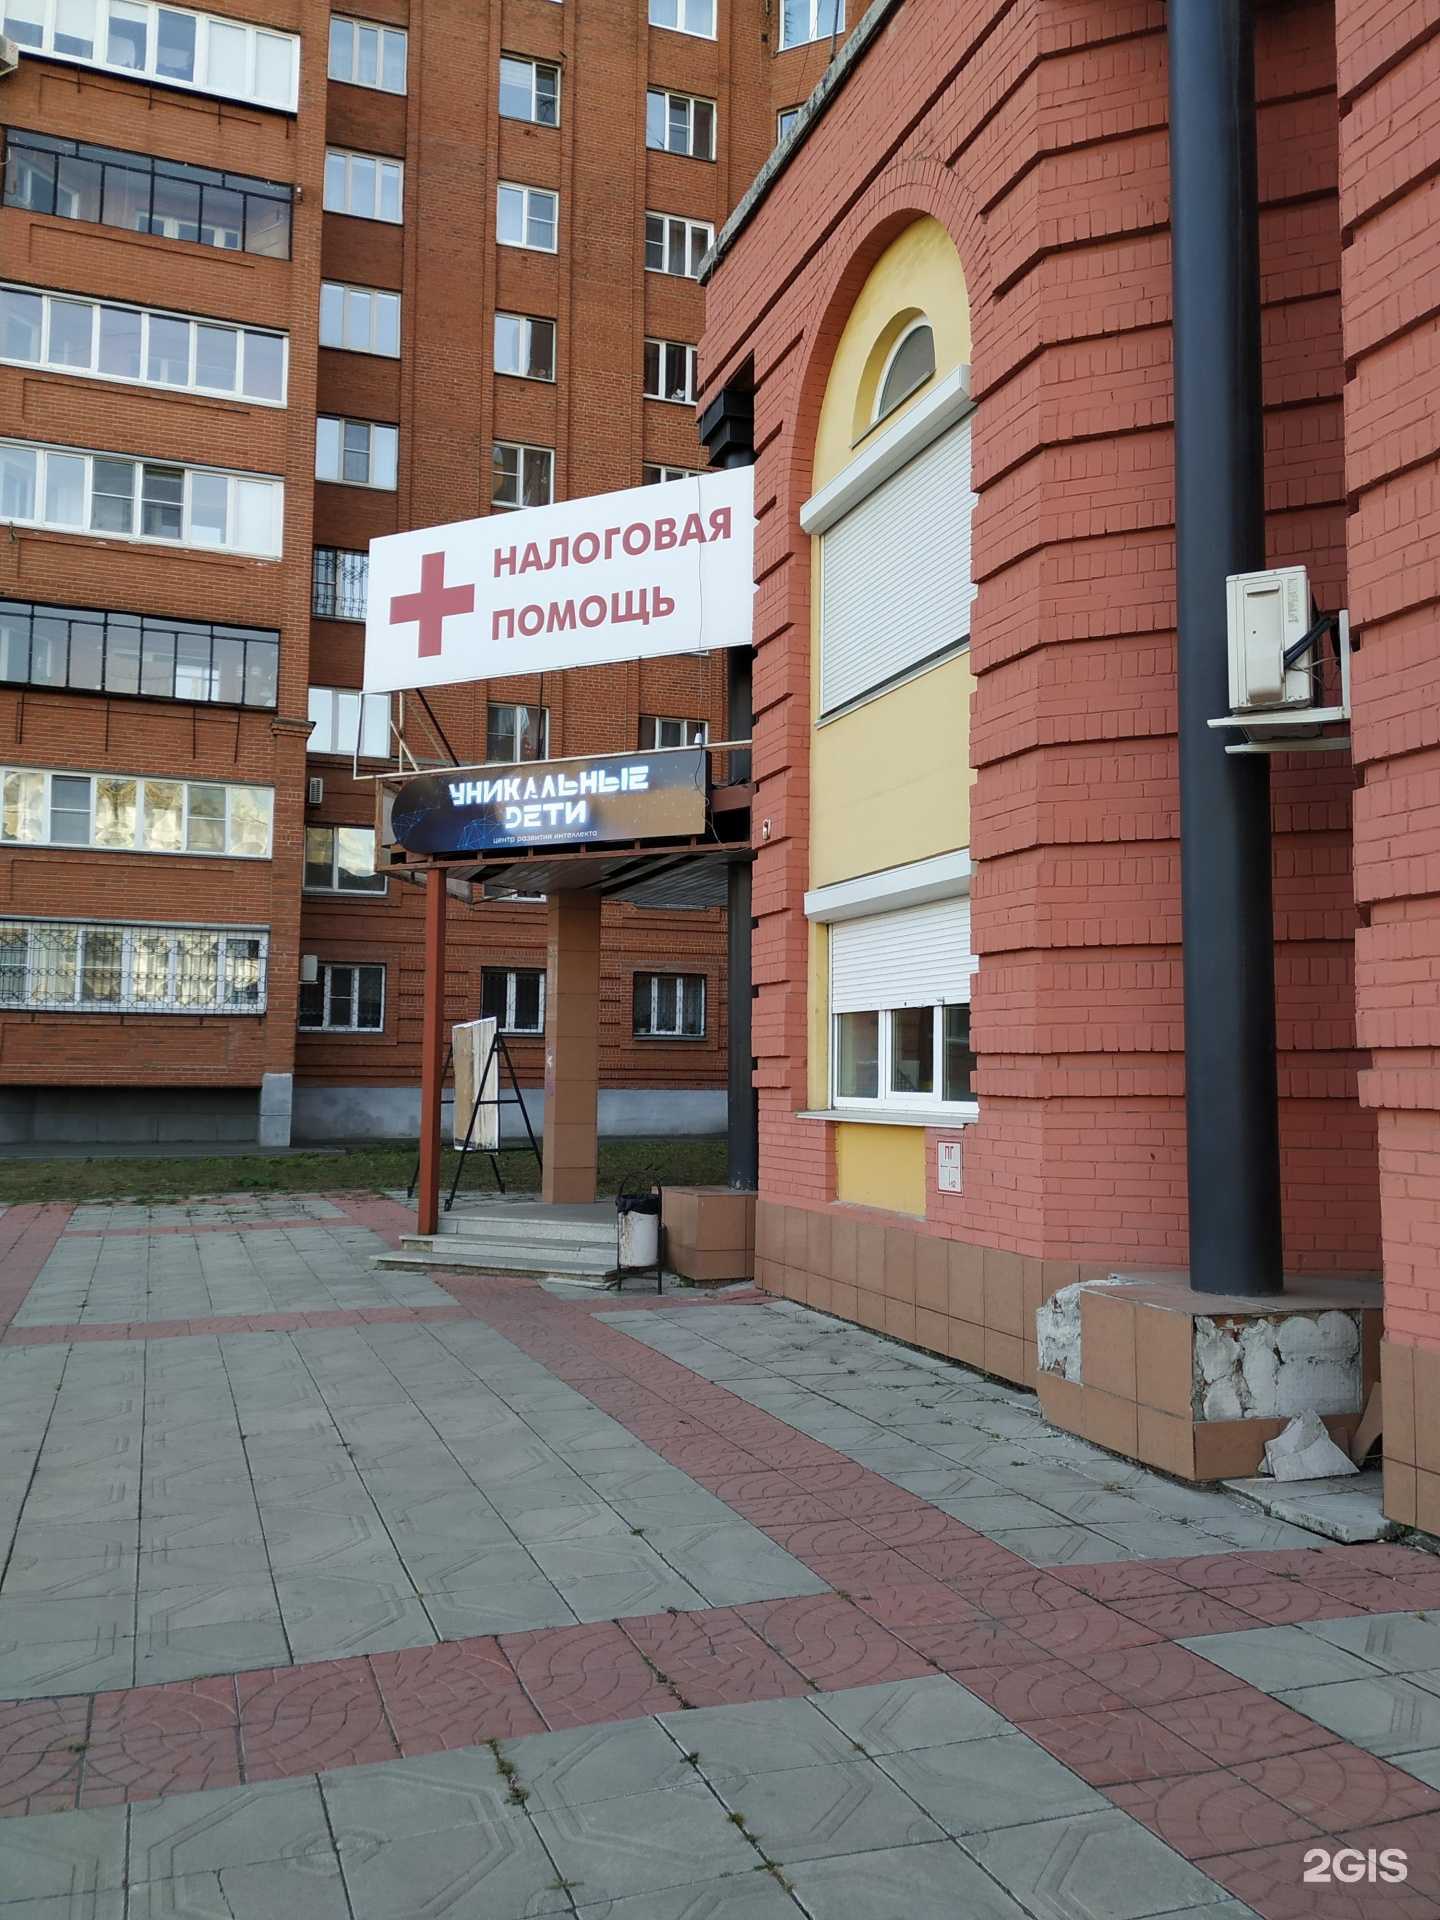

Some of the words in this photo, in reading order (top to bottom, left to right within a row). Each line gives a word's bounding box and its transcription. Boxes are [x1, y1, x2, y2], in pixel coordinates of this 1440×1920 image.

[492, 506, 732, 578] НАЛОГОВАЯ
[491, 585, 675, 641] ПОМОЩЬ
[448, 765, 649, 806] УНИКАЛЬНЫЕ
[505, 800, 587, 829] ДЕТИ
[493, 836, 515, 844] центр
